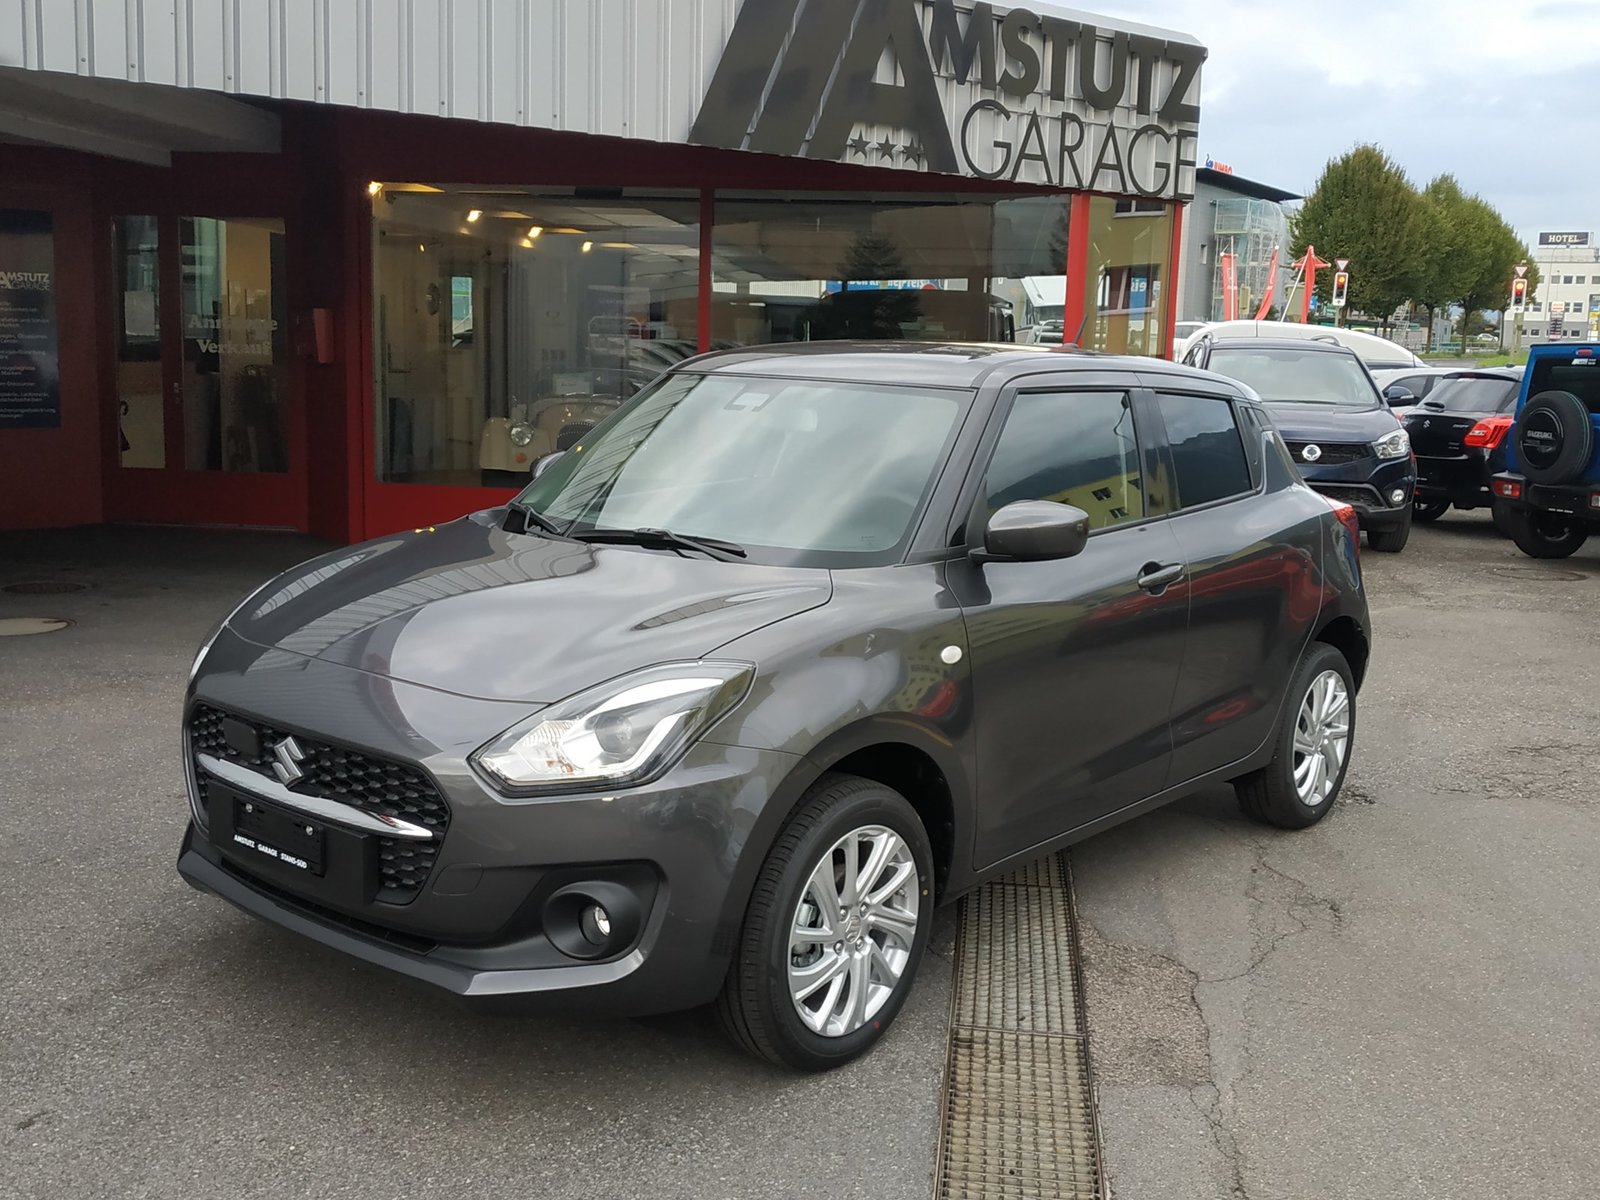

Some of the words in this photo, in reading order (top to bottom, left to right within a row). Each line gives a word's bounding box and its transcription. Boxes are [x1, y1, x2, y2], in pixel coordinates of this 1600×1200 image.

[804, 0, 1208, 174] AMSTUTZ
[960, 98, 1198, 200] GARAGE
[1548, 234, 1579, 243] HOTEL
[257, 843, 278, 857] GARAGE
